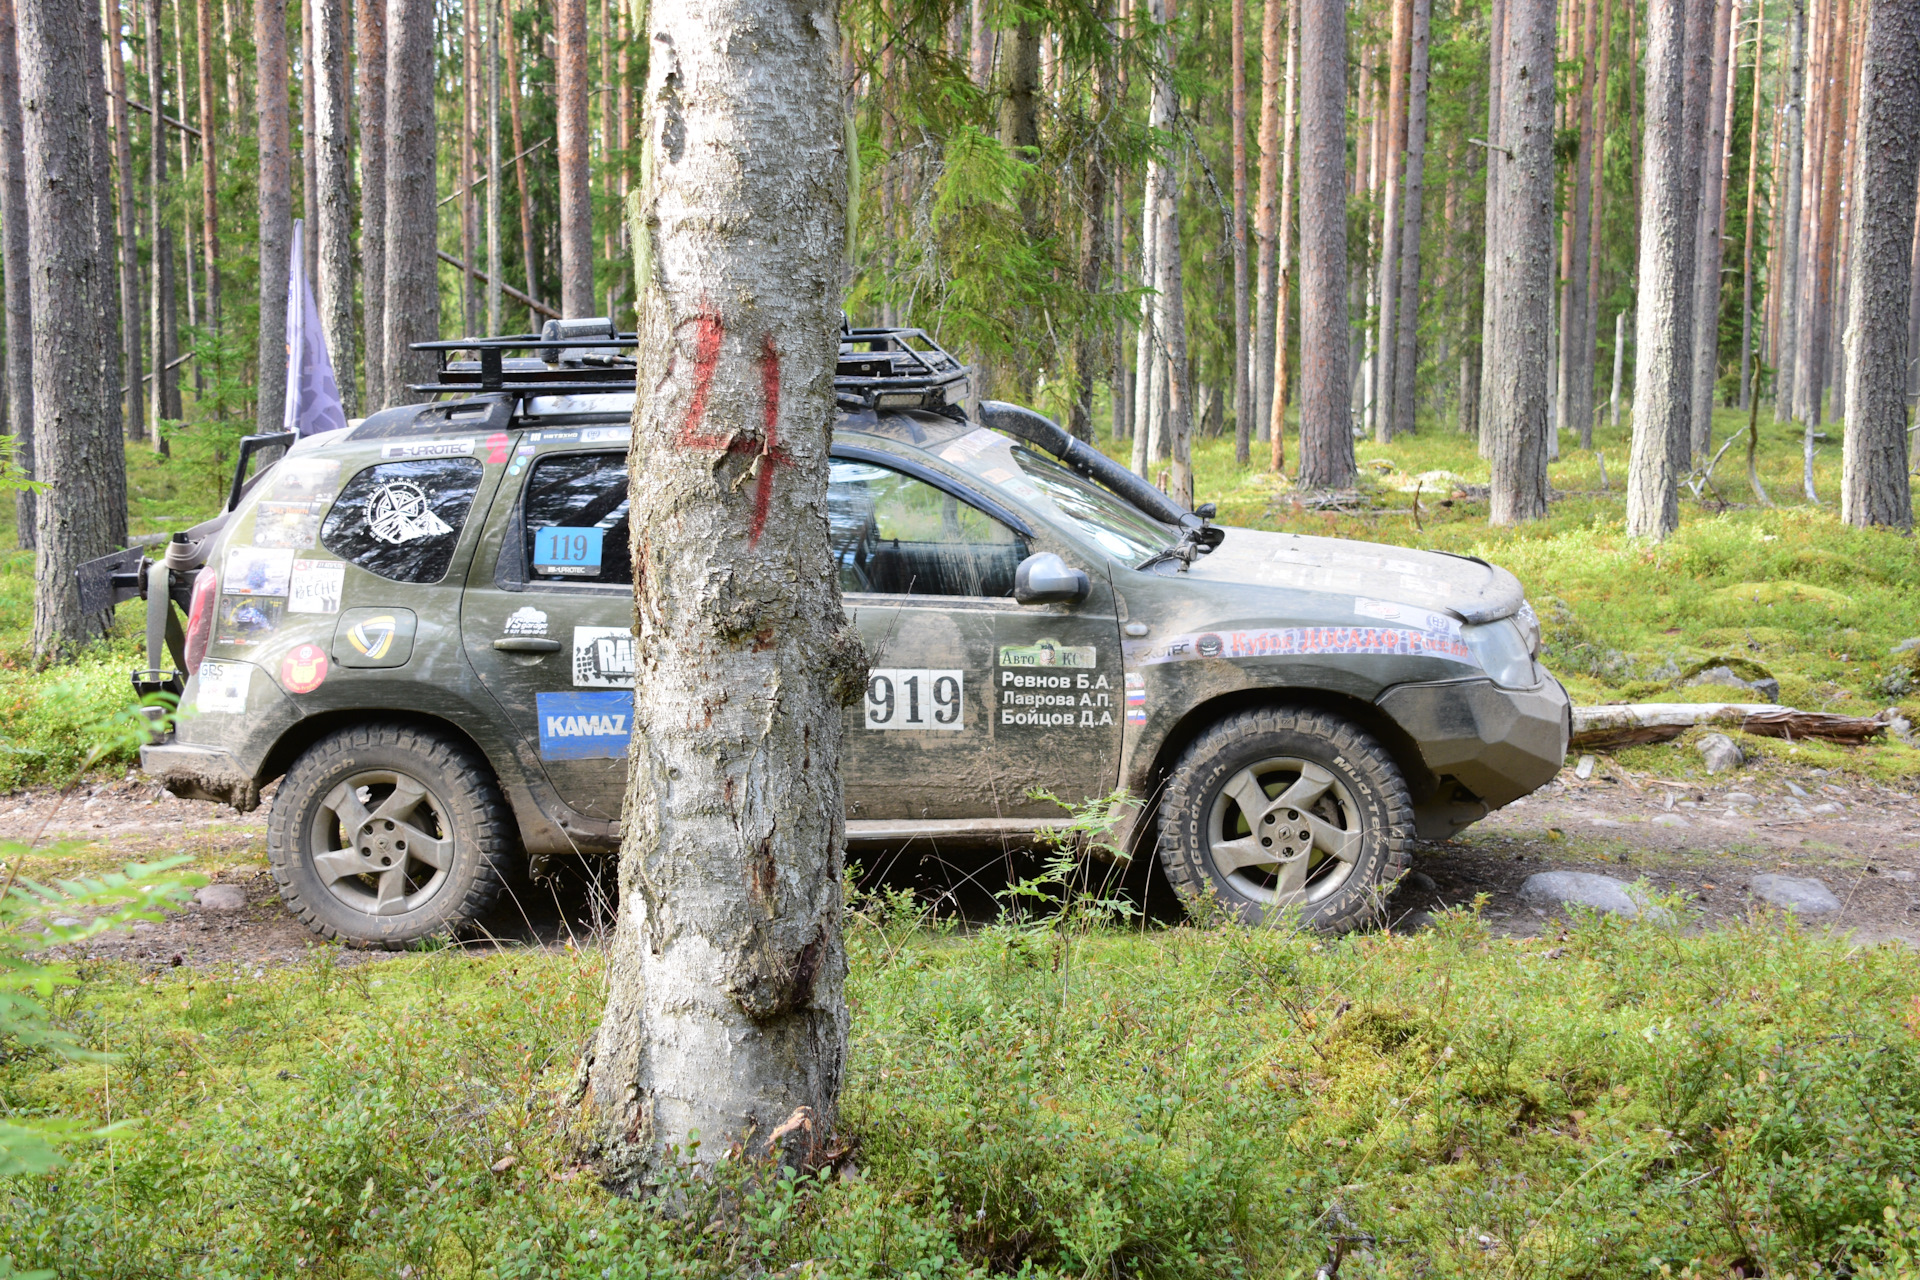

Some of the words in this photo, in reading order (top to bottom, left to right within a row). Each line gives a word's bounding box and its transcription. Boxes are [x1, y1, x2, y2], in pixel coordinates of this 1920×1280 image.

[401, 443, 467, 456] SUPROTEC
[485, 432, 509, 464] 2
[550, 534, 588, 561] 119
[505, 616, 523, 629] VS
[1231, 631, 1293, 655] Кубок
[1302, 629, 1399, 653] ДОСААФ
[1408, 630, 1469, 658] России
[1002, 651, 1035, 665] Авто
[1001, 671, 1071, 688] Ревнов
[1076, 673, 1114, 690] Б.А.
[867, 675, 961, 724] 919
[1002, 691, 1075, 708] Лаврова
[1079, 693, 1113, 707] А.П.
[546, 714, 628, 738] KAMAZ
[1001, 709, 1075, 727] Бойцов
[1079, 710, 1118, 728] Д.А.
[290, 757, 356, 868] BFGoodrich
